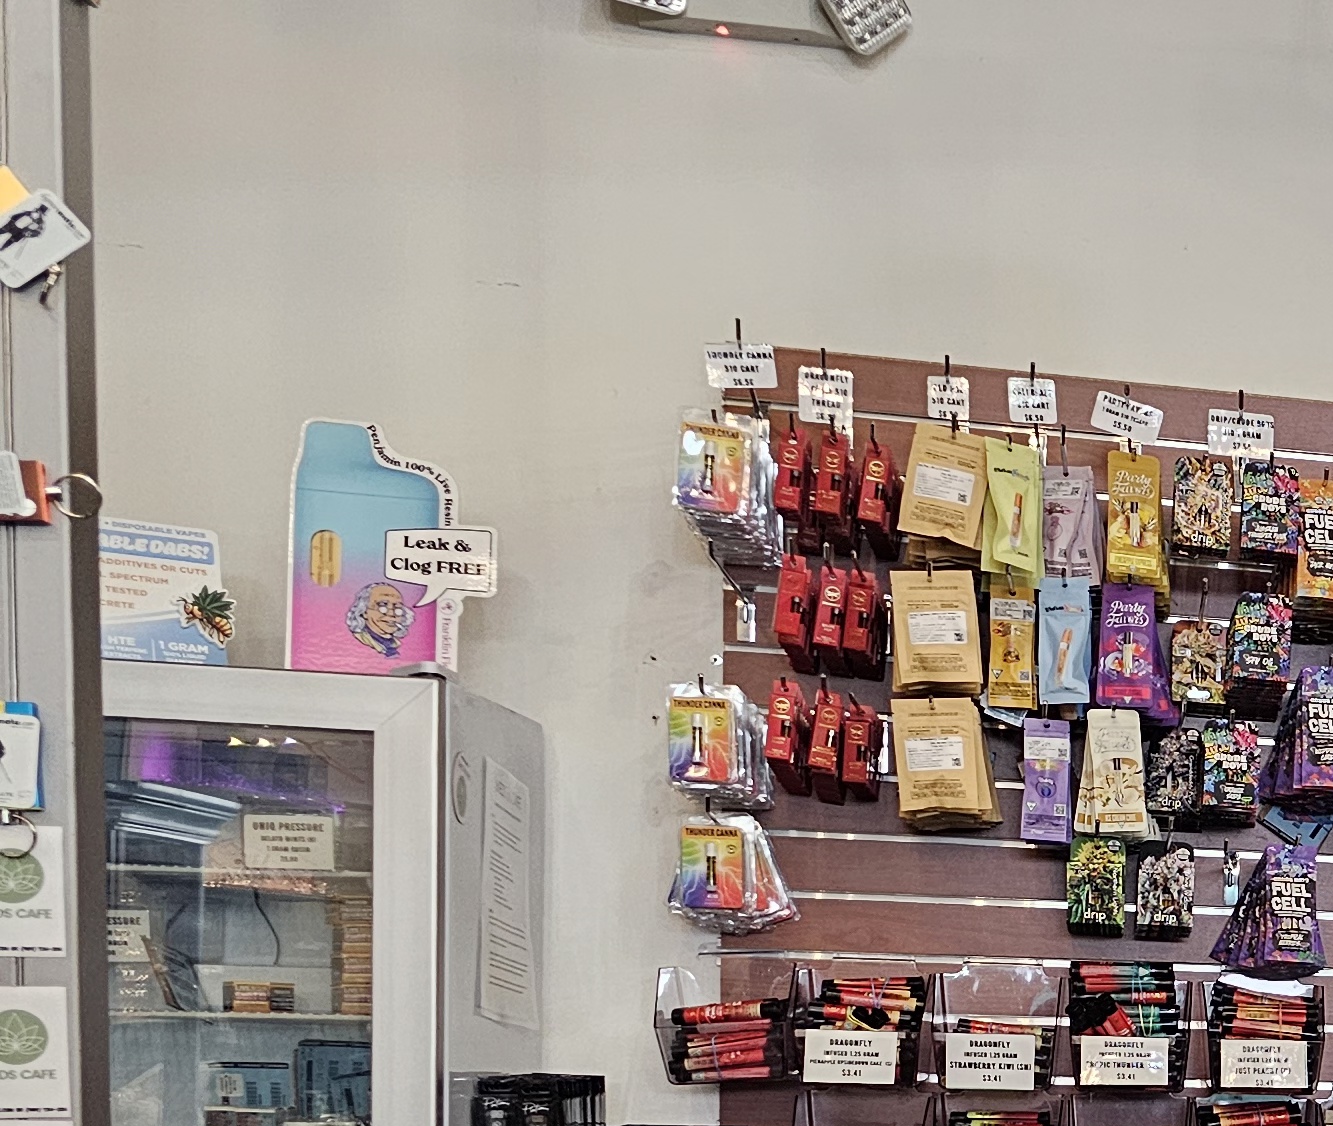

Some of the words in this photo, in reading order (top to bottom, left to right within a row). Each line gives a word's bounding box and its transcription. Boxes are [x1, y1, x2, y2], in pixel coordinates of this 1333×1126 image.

[366, 423, 402, 468] Penjamin
[404, 460, 435, 476] 100%
[434, 472, 452, 496] Live
[443, 498, 454, 527] Resin
[111, 520, 173, 536] DISPOSABLE
[174, 527, 207, 540] VAPES
[149, 539, 210, 561] DABS!
[403, 535, 450, 552] Leak
[453, 539, 472, 553] &
[160, 564, 178, 573] OR
[179, 566, 208, 577] CUTS
[390, 557, 433, 576] Clog
[436, 560, 488, 576] FREE
[109, 571, 170, 586] SPECTRUM
[105, 585, 149, 598] TESTED
[107, 634, 137, 647] HTE
[441, 617, 453, 657] Franklin
[167, 641, 209, 655] GRAM
[278, 822, 325, 833] PRESSURE
[17, 908, 54, 920] CAFE
[829, 1038, 873, 1048] DRAGONFLY
[969, 1039, 1011, 1049] DRAGONFLY
[949, 1061, 996, 1071] STRAWBERRY
[841, 1069, 862, 1077] $3.41
[982, 1074, 1002, 1083] $3.41
